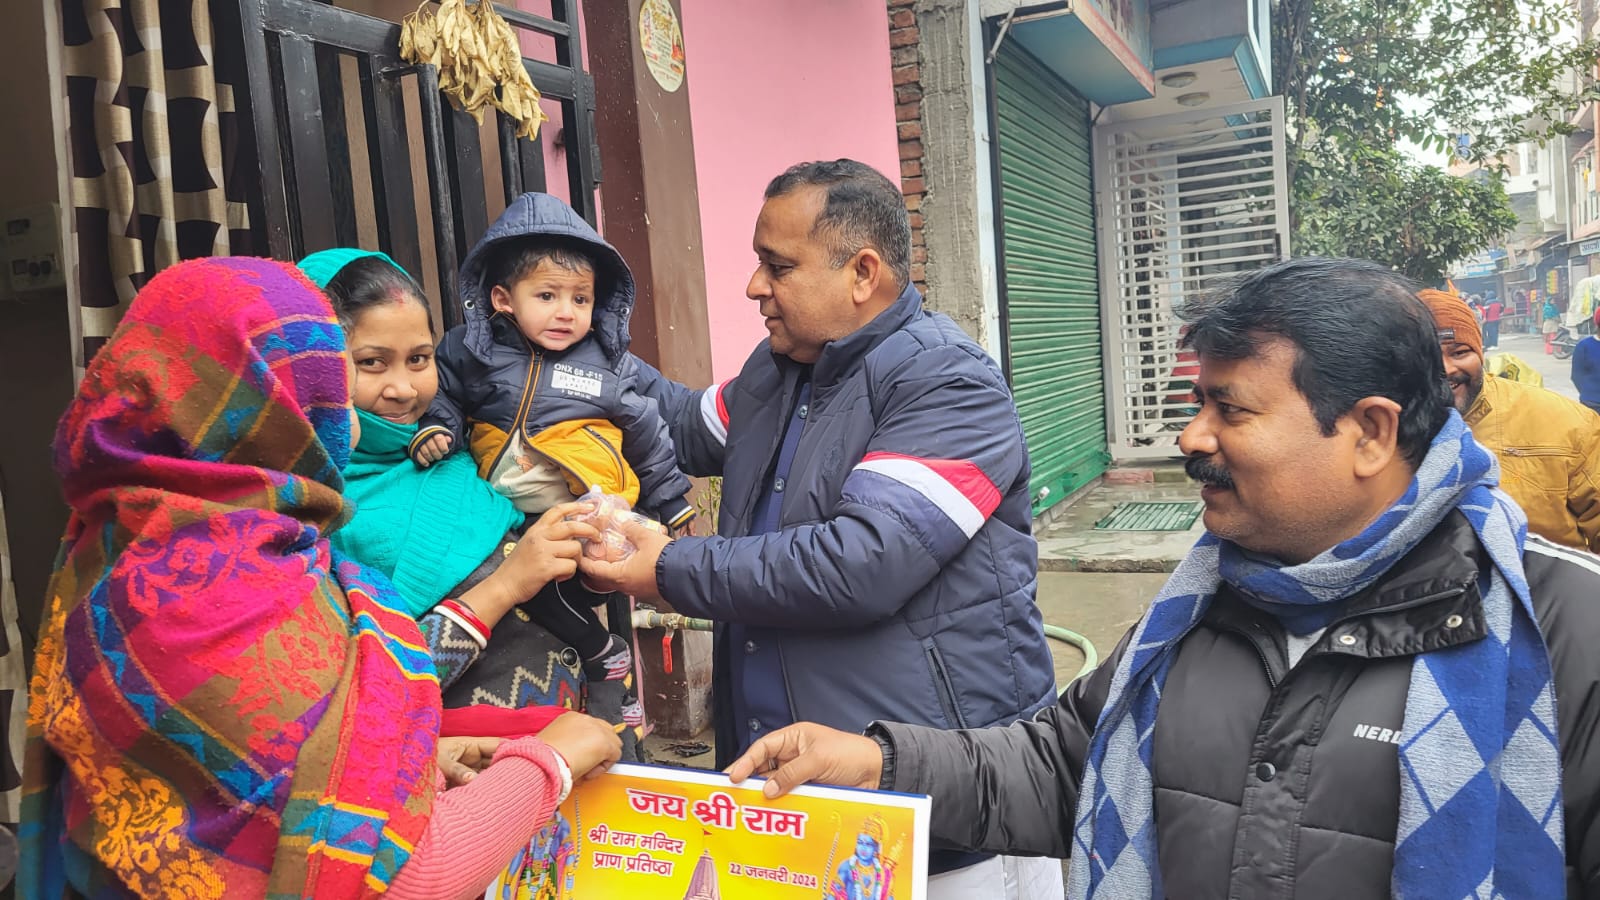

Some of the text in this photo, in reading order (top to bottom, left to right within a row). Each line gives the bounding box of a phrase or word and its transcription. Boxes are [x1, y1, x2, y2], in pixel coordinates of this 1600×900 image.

[627, 789, 805, 837] जय श्री राम
[589, 825, 685, 854] श्री राम मन्दिर
[594, 853, 673, 876] प्राण प्रतिष्ठा
[729, 863, 817, 887] 22 जनवरी 2024
